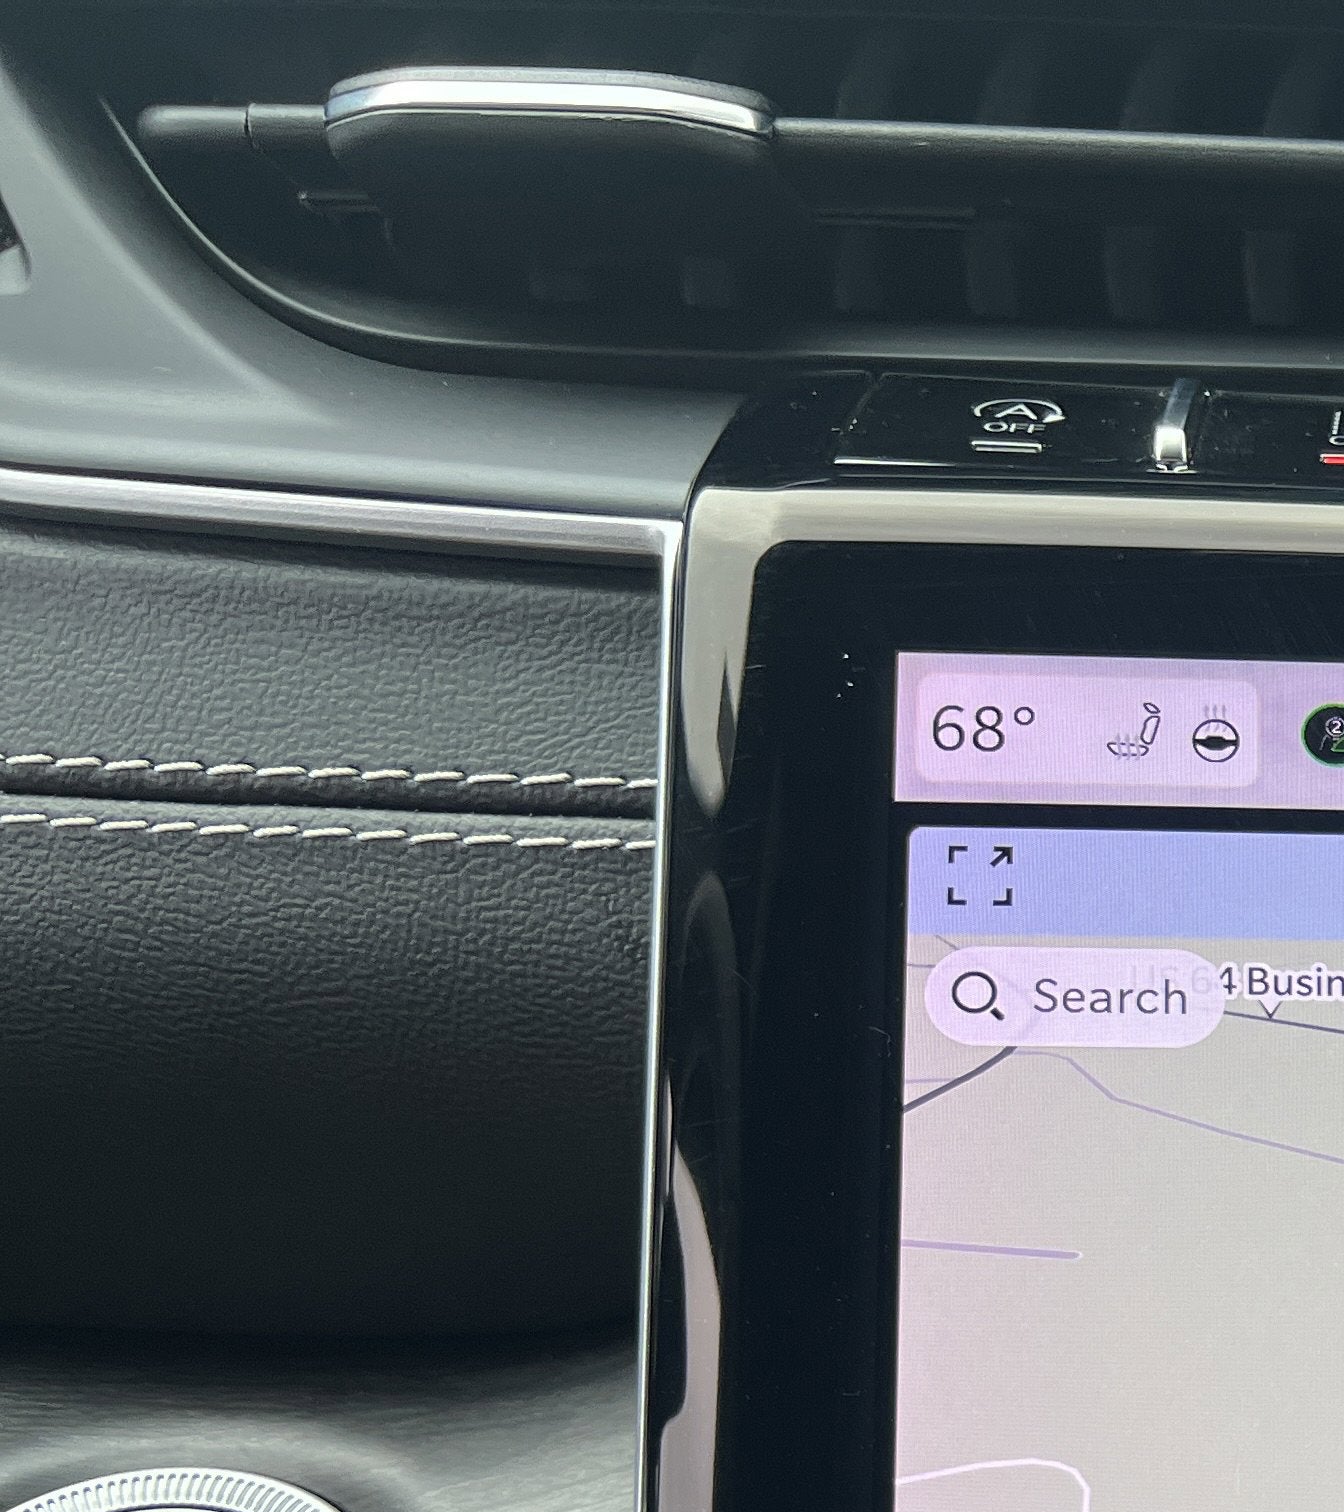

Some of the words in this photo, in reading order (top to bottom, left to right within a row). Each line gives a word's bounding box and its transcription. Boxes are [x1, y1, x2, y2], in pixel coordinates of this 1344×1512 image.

[983, 421, 1046, 434] OFF
[931, 703, 1036, 753] 68°
[1032, 977, 1188, 1016] Search
